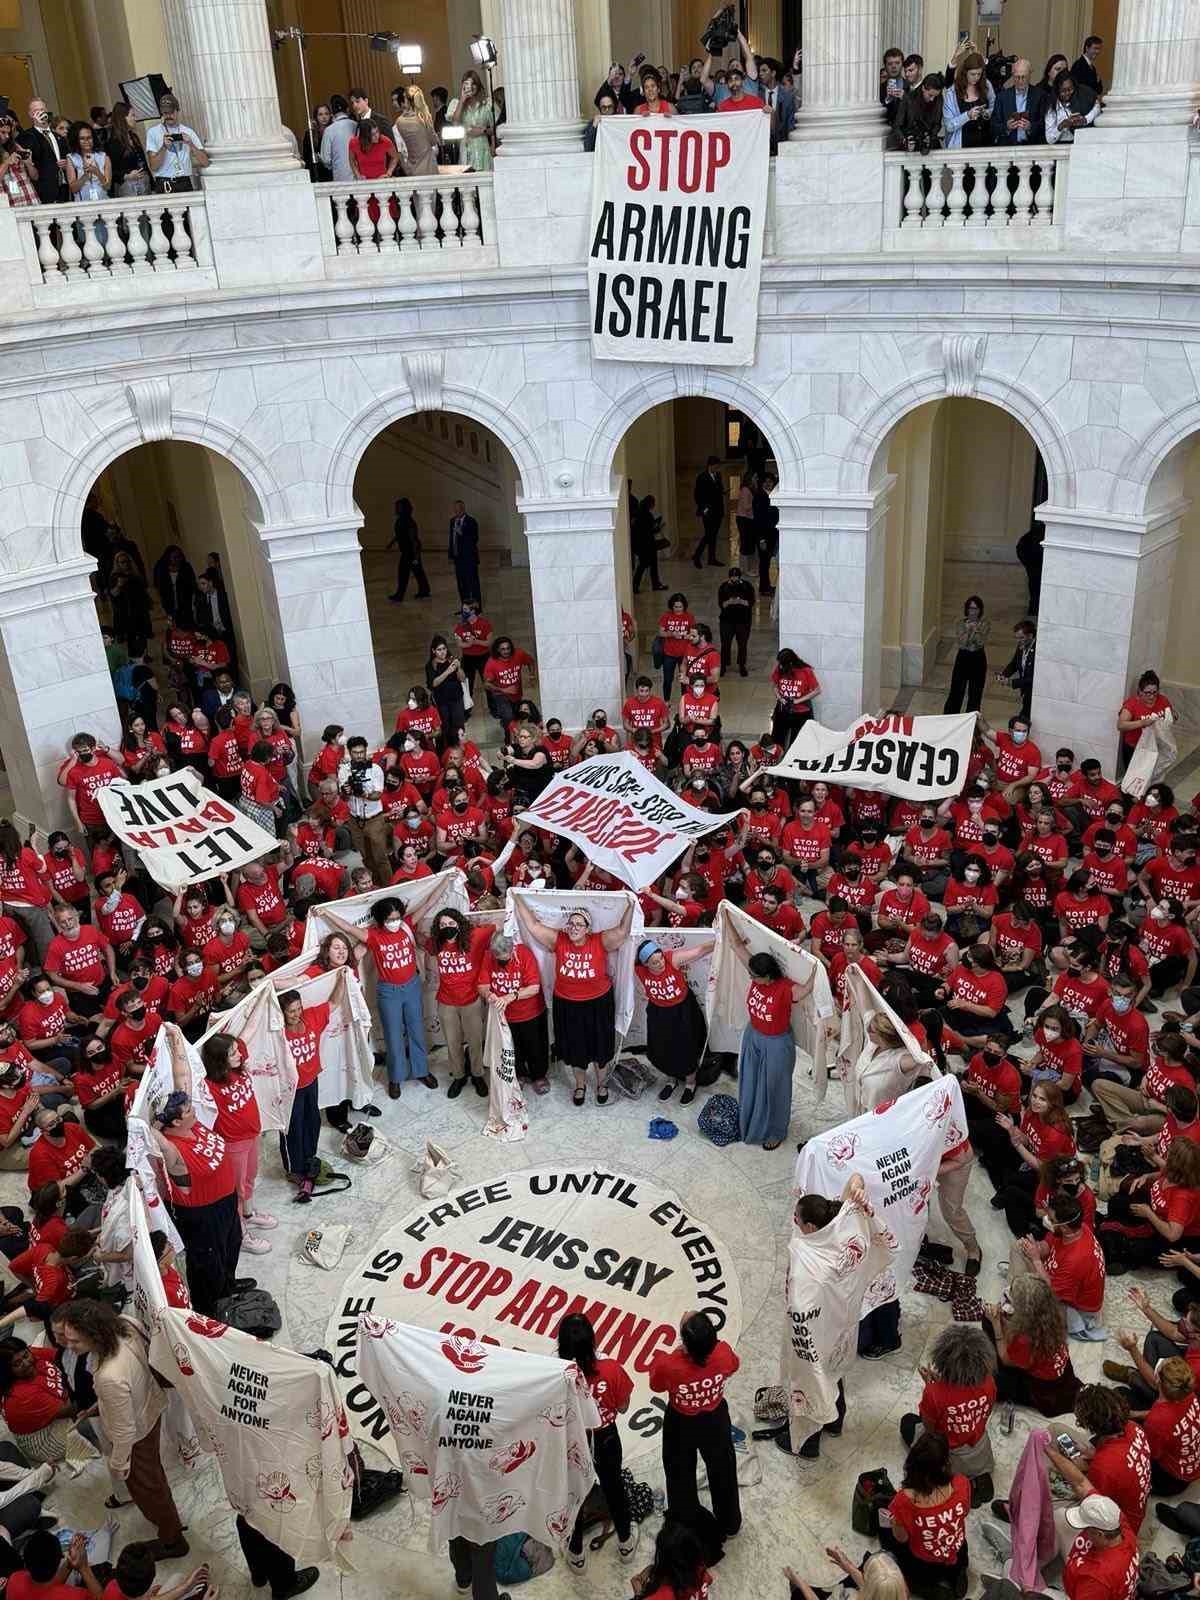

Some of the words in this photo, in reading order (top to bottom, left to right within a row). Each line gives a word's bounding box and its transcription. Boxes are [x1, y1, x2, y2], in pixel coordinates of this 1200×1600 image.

[627, 129, 731, 193] STOP
[591, 201, 751, 268] ARMING
[594, 272, 733, 343] ISRAEL
[1015, 757, 1024, 765] IN
[176, 826, 254, 878] LET
[837, 884, 866, 896] JEWS
[1161, 878, 1180, 888] NOT
[1164, 886, 1188, 895] OUR
[885, 905, 904, 916] NOT
[380, 944, 401, 952] NOT
[402, 938, 410, 946] IN
[1000, 934, 1024, 948] STOP
[1161, 938, 1170, 947] IN
[65, 944, 93, 960] STOP
[65, 950, 98, 966] ARMING
[385, 947, 411, 960] OUR
[566, 952, 583, 961] NOT
[585, 953, 592, 961] IN
[910, 946, 926, 957] NOT
[927, 951, 938, 963] IN
[383, 956, 413, 970] NAME
[440, 957, 466, 966] OUR
[440, 963, 473, 975] NAME
[566, 961, 590, 970] OUR
[911, 955, 932, 968] OUR
[560, 966, 596, 979] NAME
[497, 979, 521, 989] OUR
[645, 979, 662, 988] NOT
[664, 975, 676, 985] IN
[957, 977, 974, 991] NOT
[977, 987, 987, 999] IN
[650, 986, 675, 996] OUR
[752, 986, 767, 999] NOT
[749, 997, 767, 1013] OUR
[1083, 995, 1093, 1006] IN
[287, 1036, 307, 1048] NOT
[292, 1041, 318, 1056] OUR
[92, 1077, 111, 1093] NOT
[231, 1077, 254, 1102] OUR
[1146, 1070, 1166, 1093] OUR
[1163, 1074, 1175, 1088] IN
[203, 1132, 218, 1158] OUR
[209, 1134, 226, 1171] NAME
[64, 1143, 88, 1169] STOP
[876, 1147, 909, 1170] NEVER
[881, 1162, 912, 1183] AGAIN
[529, 1170, 641, 1208] UNTIL
[891, 1175, 911, 1192] FOR
[883, 1180, 920, 1208] ANYONE
[405, 1180, 512, 1242] FREE
[479, 1216, 591, 1271] JEWS
[585, 1247, 674, 1297] SAY
[362, 1249, 404, 1282] IS
[403, 1247, 514, 1311] STOP
[495, 1279, 679, 1375] ARMING
[337, 1296, 375, 1378] ONE
[229, 1362, 269, 1388] NEVER
[227, 1380, 267, 1400] AGAIN
[678, 1374, 723, 1394] STOP
[233, 1395, 258, 1413] FOR
[346, 1375, 392, 1441] NO
[447, 1390, 495, 1410] NEVER
[947, 1395, 988, 1415] STOP
[220, 1404, 271, 1430] ANYONE
[446, 1407, 492, 1424] AGAIN
[1173, 1397, 1200, 1437] JEWS
[453, 1423, 480, 1437] FOR
[439, 1436, 494, 1450] ANYONE
[1127, 1426, 1145, 1469] JEWS
[916, 1502, 964, 1528] JEWS
[923, 1518, 960, 1540] SAY
